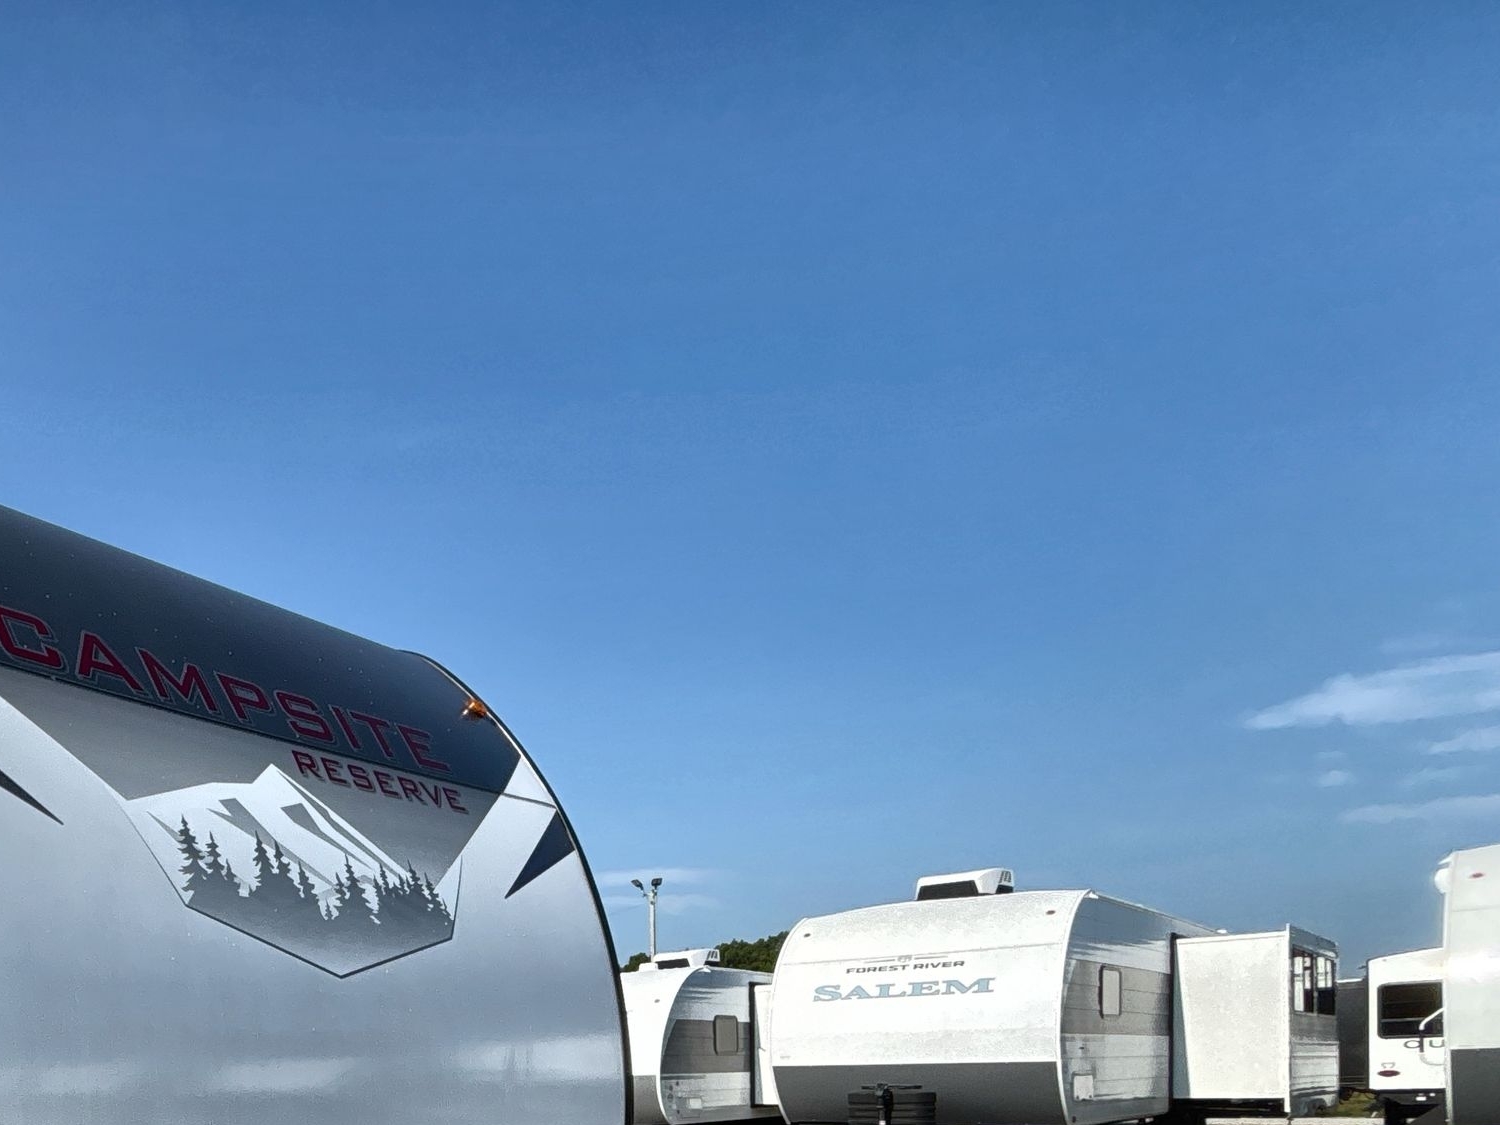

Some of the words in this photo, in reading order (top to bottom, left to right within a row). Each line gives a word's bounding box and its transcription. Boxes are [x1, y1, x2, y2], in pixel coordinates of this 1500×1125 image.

[291, 749, 469, 815] RESERVE
[846, 964, 910, 974] FOREST
[913, 960, 965, 970] RIVER
[813, 977, 996, 1002] SALEM
